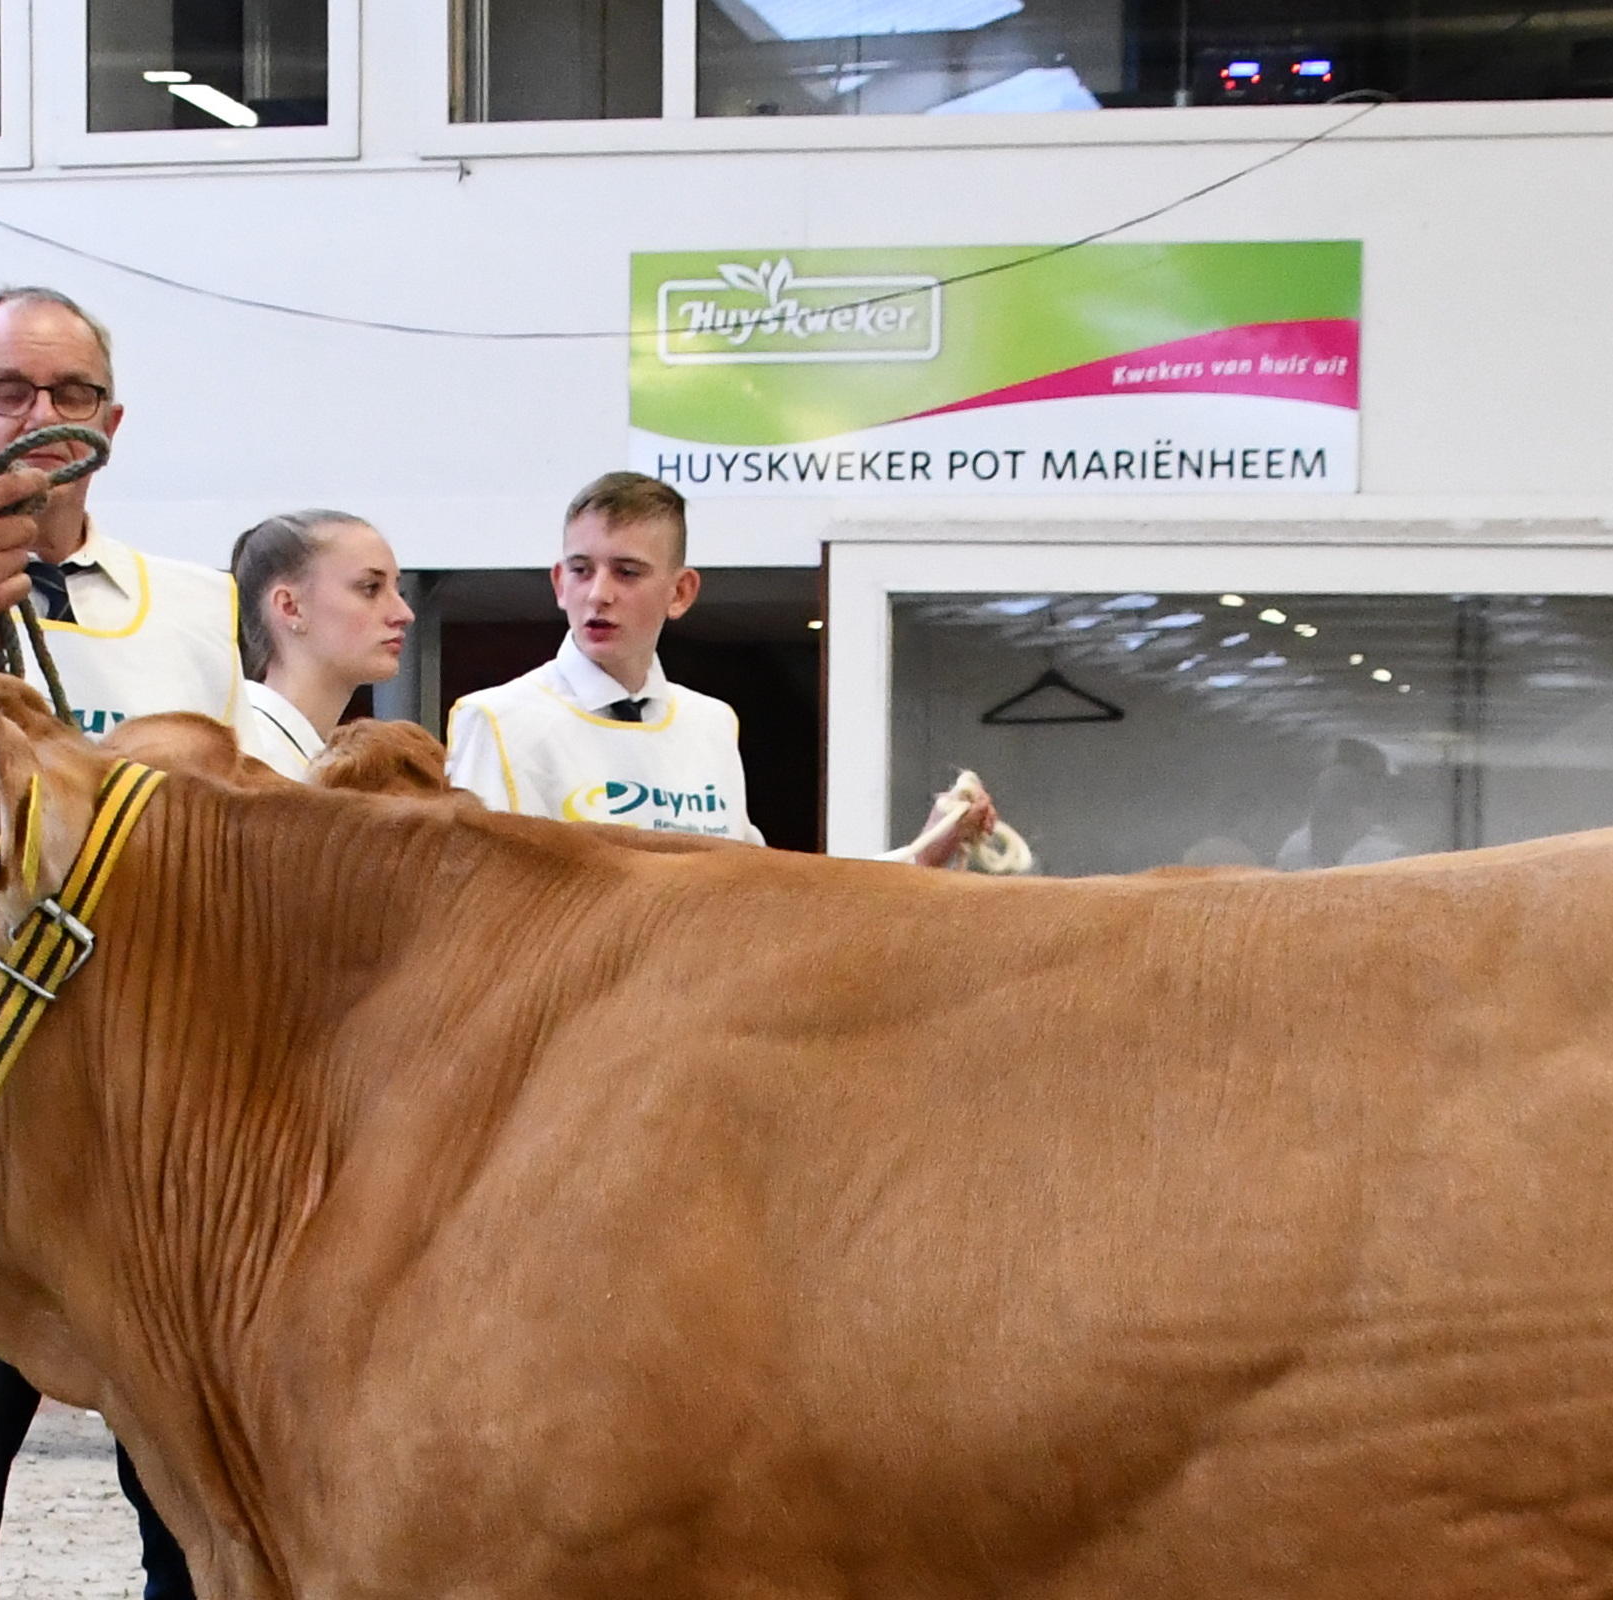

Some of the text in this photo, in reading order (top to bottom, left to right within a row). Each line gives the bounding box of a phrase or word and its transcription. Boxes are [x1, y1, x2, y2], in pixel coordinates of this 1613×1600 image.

[1112, 354, 1349, 387] Kwekers van huis uit
[657, 439, 1328, 484] HUYSKWEKER POT MARIËNHEEM
